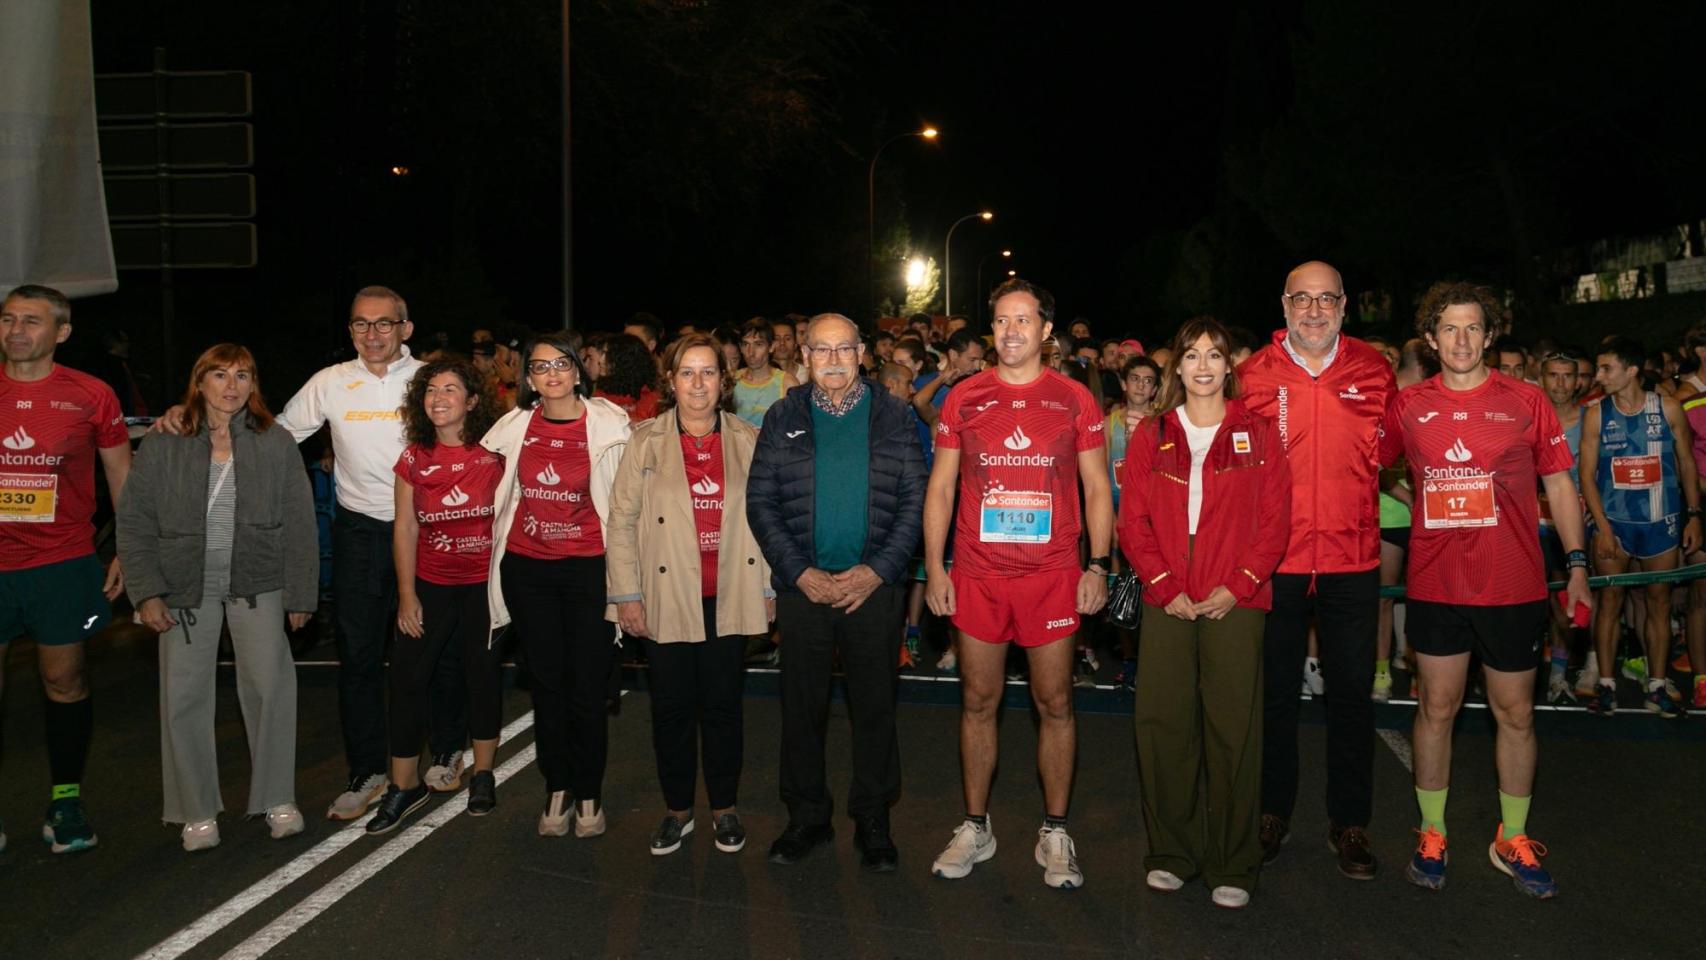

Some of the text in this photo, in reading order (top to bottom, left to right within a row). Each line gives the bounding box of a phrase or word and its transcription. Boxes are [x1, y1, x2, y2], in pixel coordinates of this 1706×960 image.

[1339, 392, 1366, 400] Santander
[1277, 385, 1287, 442] Santander
[980, 453, 1055, 467] Santander
[1629, 469, 1645, 478] 22
[1438, 481, 1489, 491] Santander
[0, 493, 36, 504] 330
[999, 496, 1049, 506] Santander
[1448, 497, 1466, 509] 17
